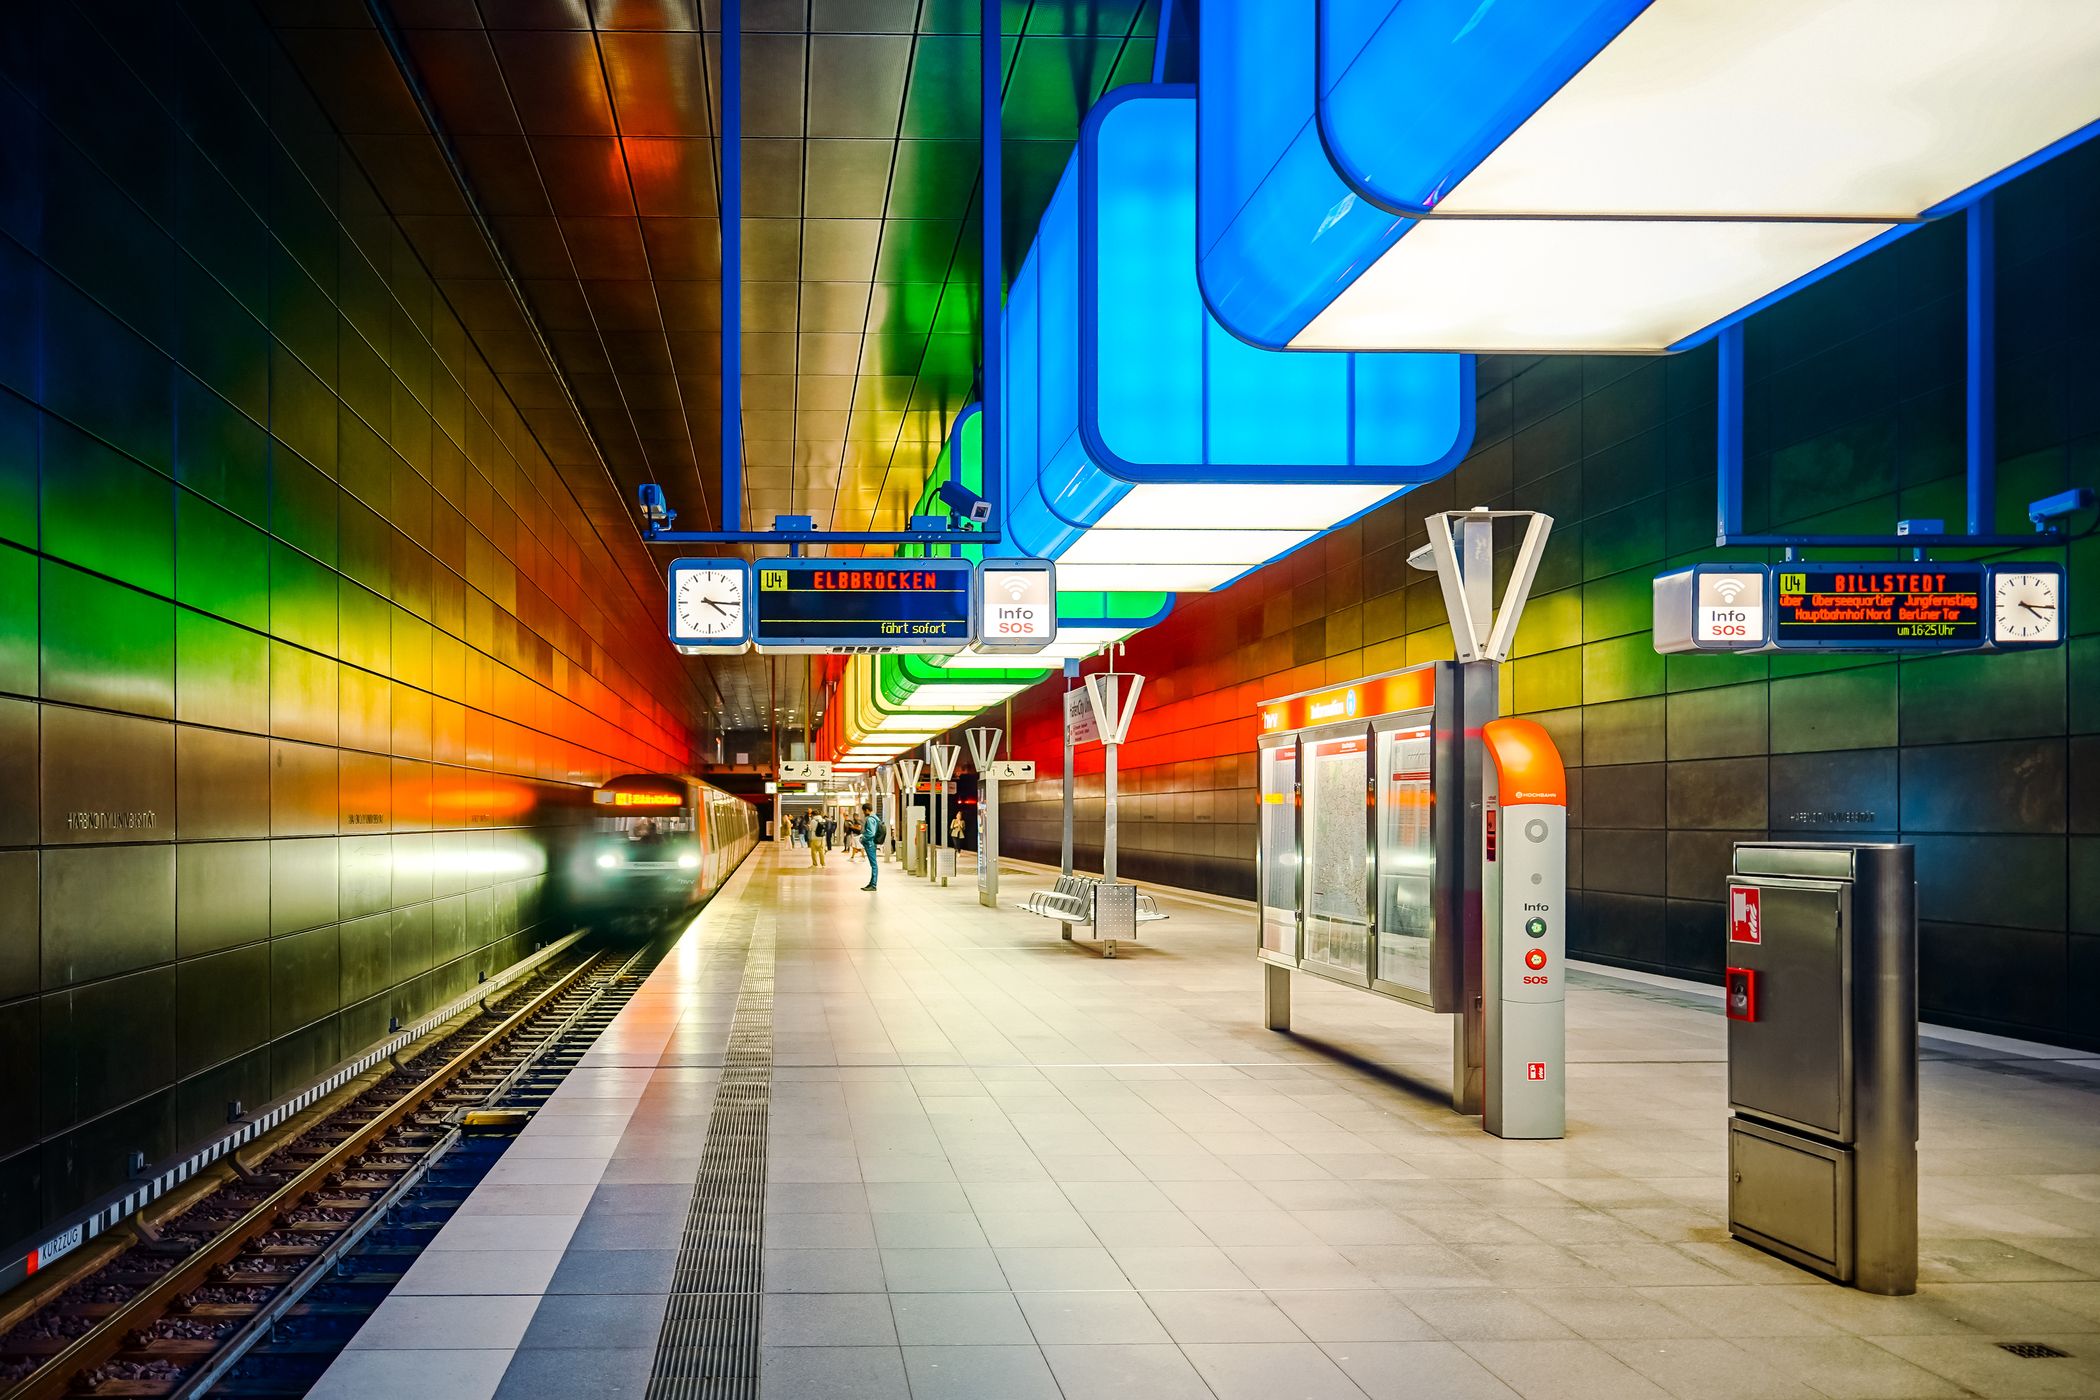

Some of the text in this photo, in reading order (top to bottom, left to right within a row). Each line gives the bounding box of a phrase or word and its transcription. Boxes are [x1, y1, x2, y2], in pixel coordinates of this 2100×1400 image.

[766, 572, 782, 588] U4
[1784, 574, 1946, 593] U4 BILLSTEDT
[1904, 594, 1978, 609] Jungfernstieg
[999, 608, 1034, 620] Info
[1712, 610, 1746, 622] Info
[1795, 608, 1961, 623] Hauptbahnhof Nord Berliner Tor
[881, 622, 947, 634] fährt sofort
[999, 623, 1034, 634] SOS
[1712, 625, 1746, 636] SOS
[1897, 627, 1910, 636] um
[1938, 624, 1956, 636] Uhr
[1524, 903, 1549, 912] Info
[1523, 976, 1548, 985] SOS
[42, 1228, 78, 1260] KURZZUG
